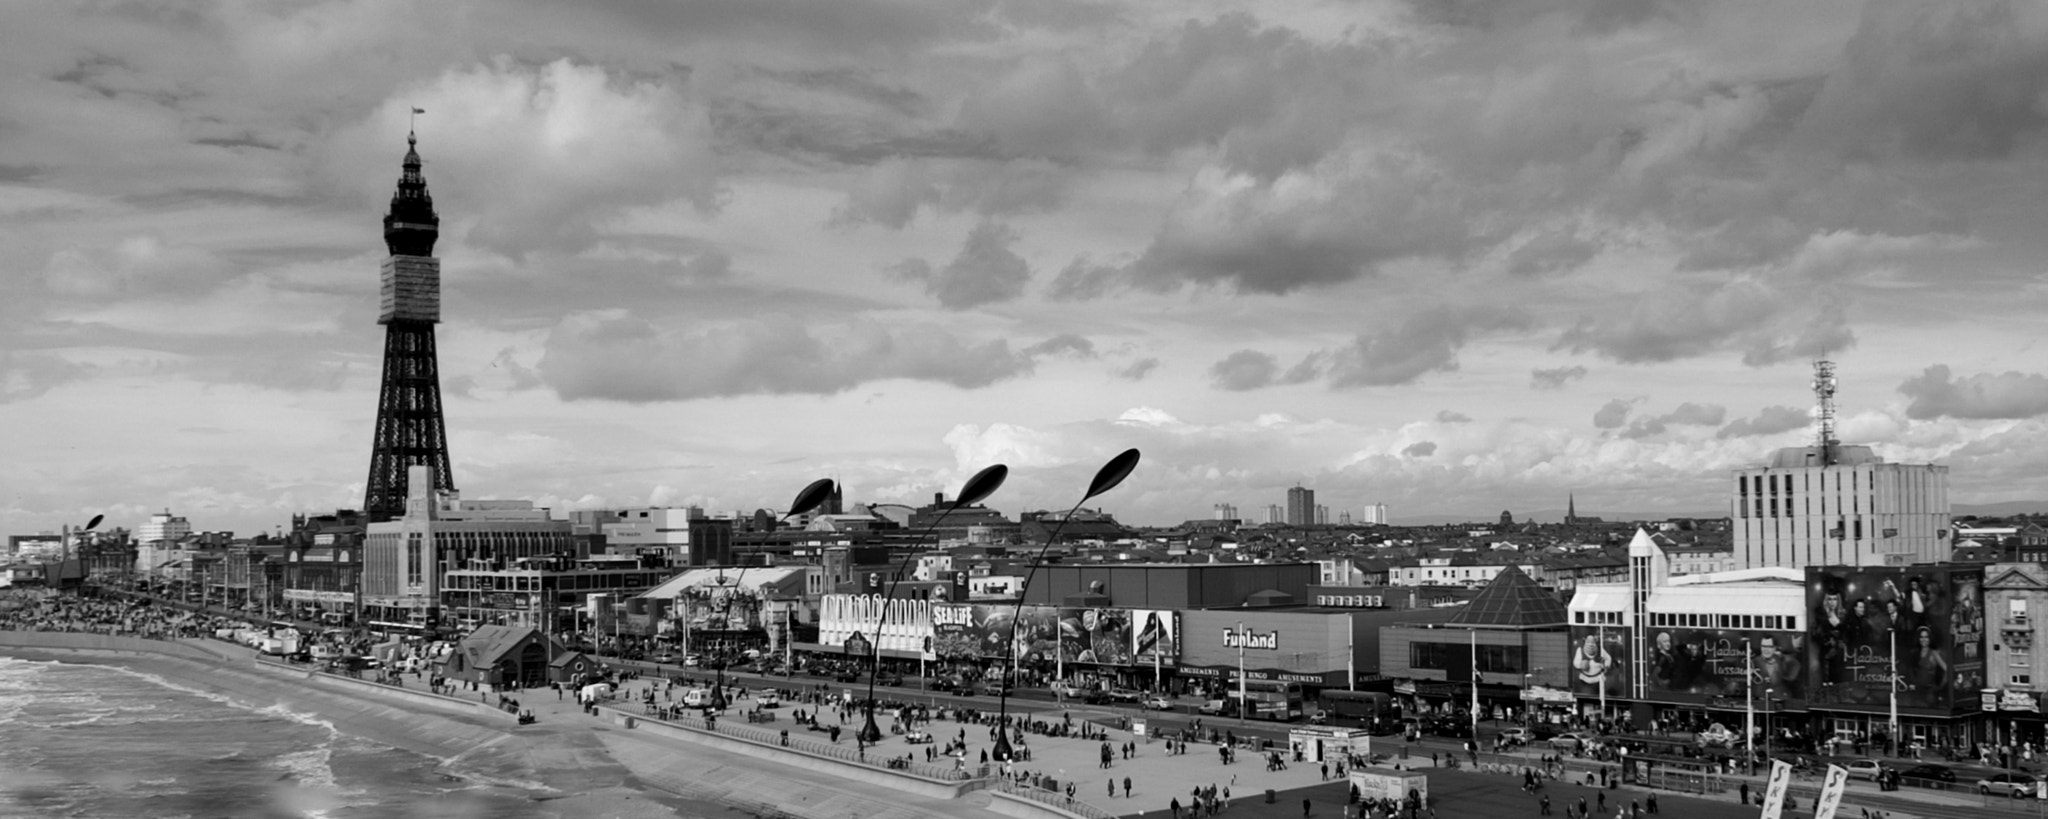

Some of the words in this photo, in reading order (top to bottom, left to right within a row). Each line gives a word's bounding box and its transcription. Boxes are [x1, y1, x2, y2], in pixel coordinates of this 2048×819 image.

[934, 606, 954, 625] SEA
[1223, 629, 1277, 649] Funland
[1180, 667, 1219, 676] AMUSEMENTS
[1248, 671, 1268, 679] BINGO
[1278, 673, 1322, 683] AMUSEMENTS
[1767, 765, 1785, 819] SKY
